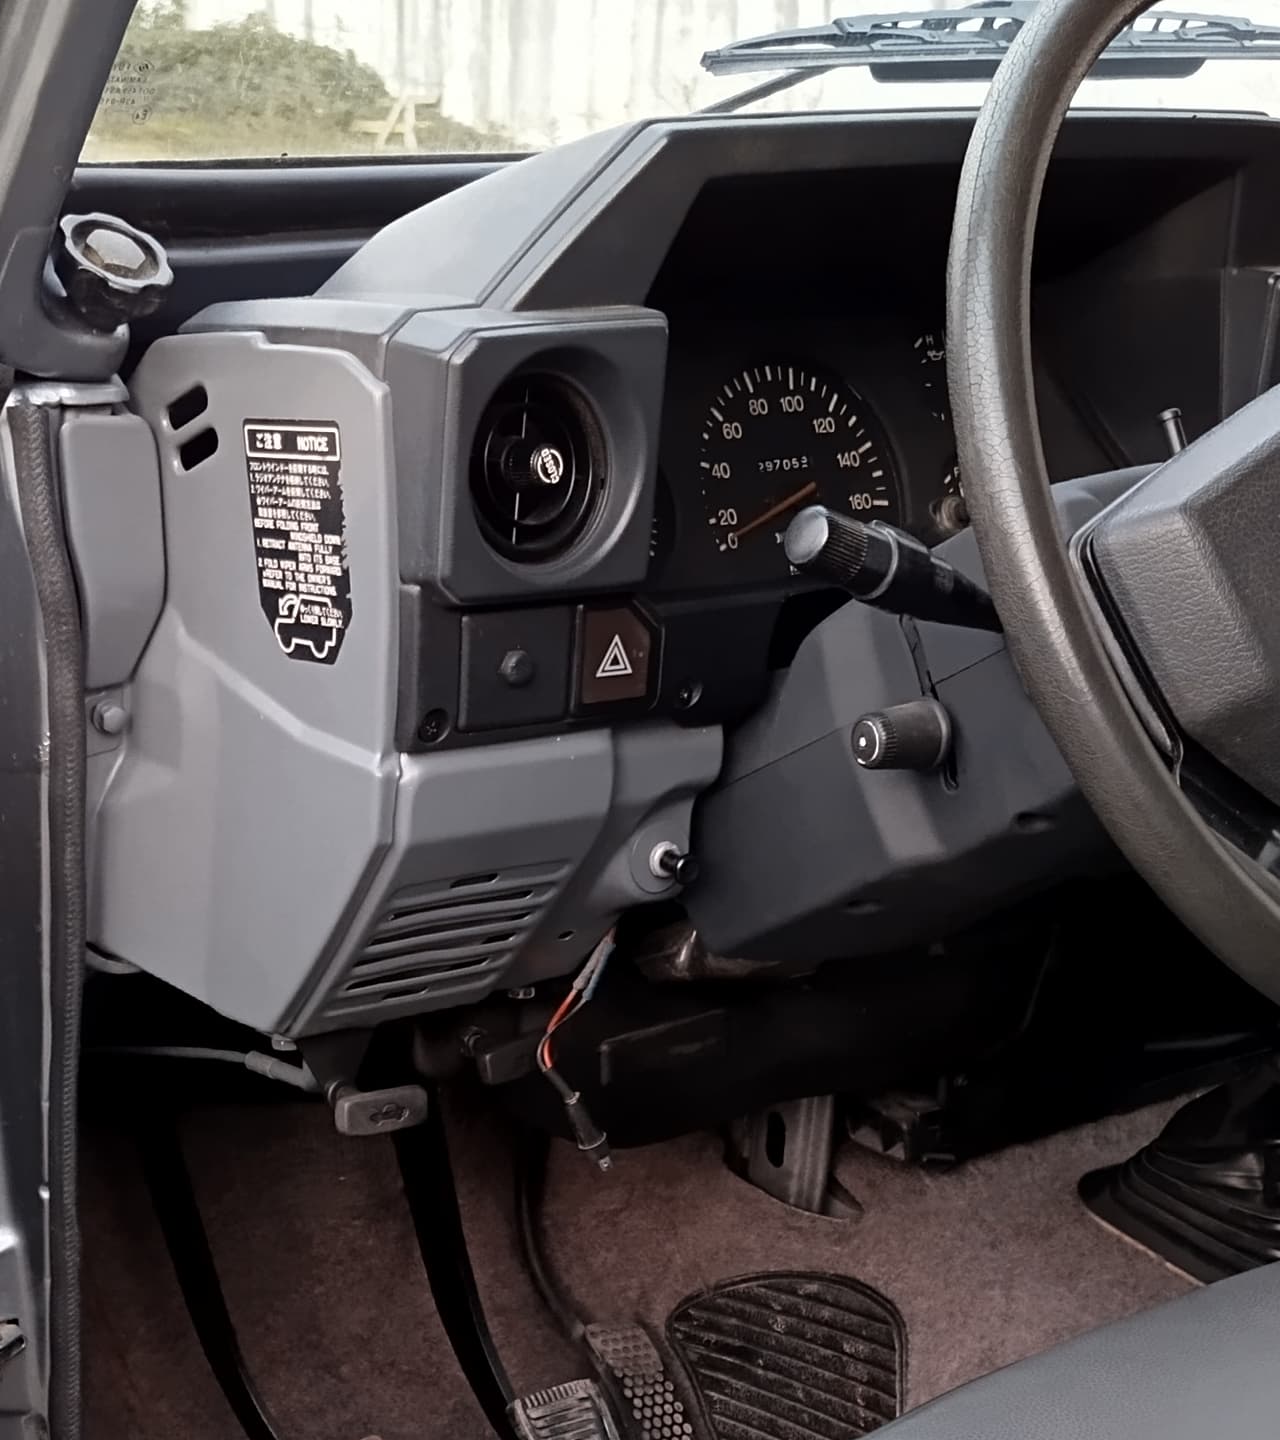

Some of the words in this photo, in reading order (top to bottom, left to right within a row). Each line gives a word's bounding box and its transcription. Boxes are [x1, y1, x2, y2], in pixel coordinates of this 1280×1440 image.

[749, 398, 768, 415] 80
[780, 395, 804, 412] 100
[722, 422, 742, 439] 60
[813, 417, 835, 434] 120
[296, 435, 329, 452] NOTICE
[541, 448, 560, 484] CLOSED
[837, 451, 860, 468] 140
[711, 462, 731, 480] 40
[848, 494, 872, 510] 160
[718, 508, 737, 525] 20
[727, 532, 738, 549] 0
